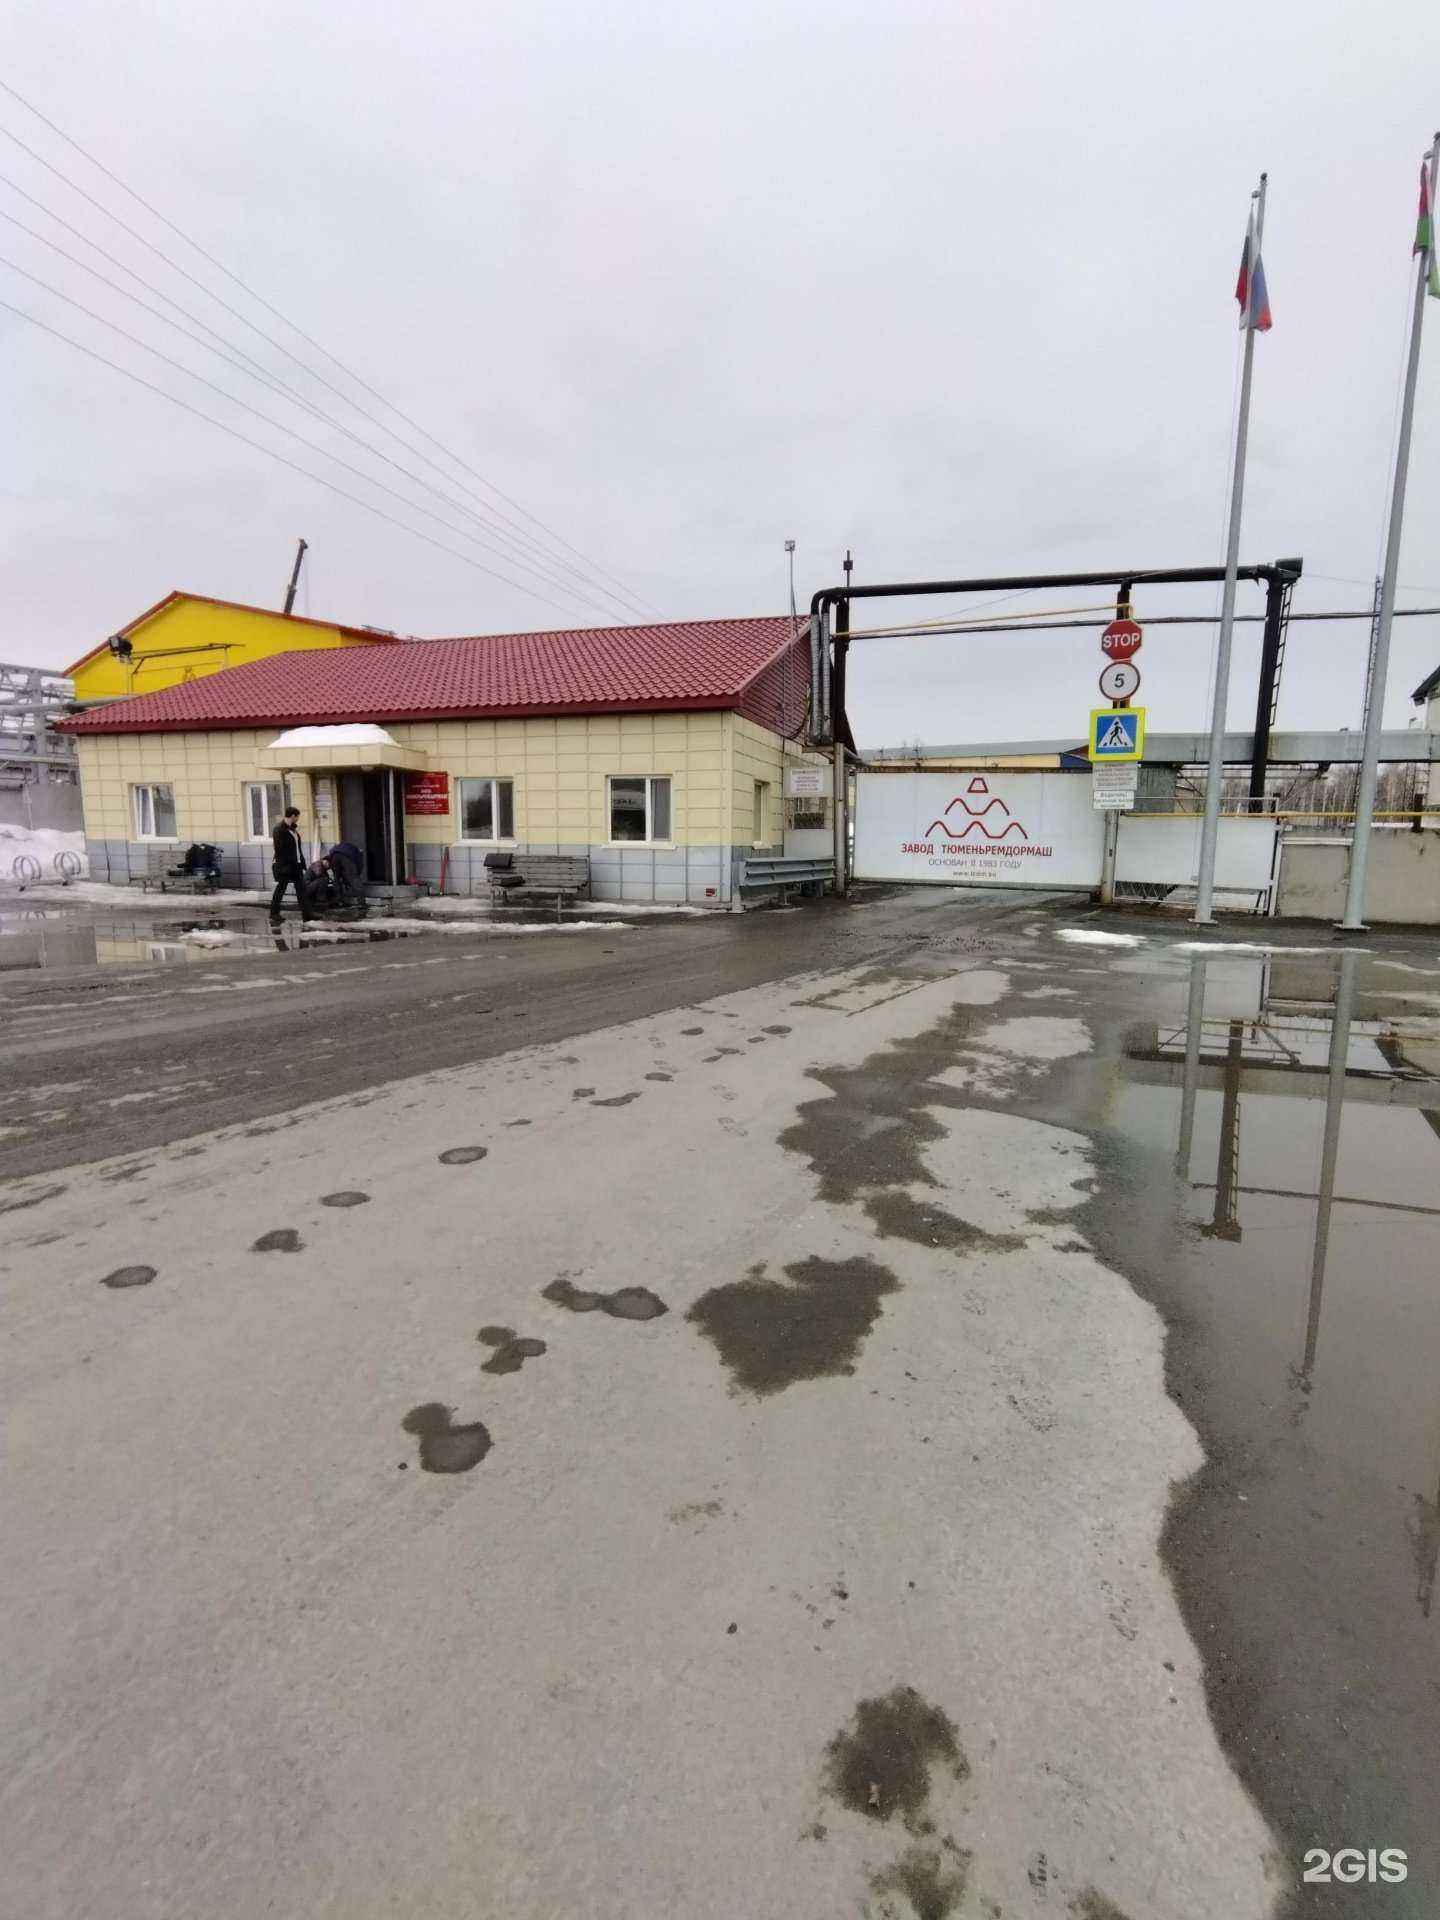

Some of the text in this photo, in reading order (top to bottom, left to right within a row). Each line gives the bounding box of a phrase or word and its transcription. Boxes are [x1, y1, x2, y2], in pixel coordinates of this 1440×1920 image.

[1103, 633, 1140, 648] STOP
[1114, 673, 1125, 688] 5
[901, 843, 1053, 857] ЗАВОД ТЮМЕНЬРЕМДОРМАШ
[928, 858, 968, 866] ОСНОВАН
[1000, 860, 1022, 869] ГОДУ
